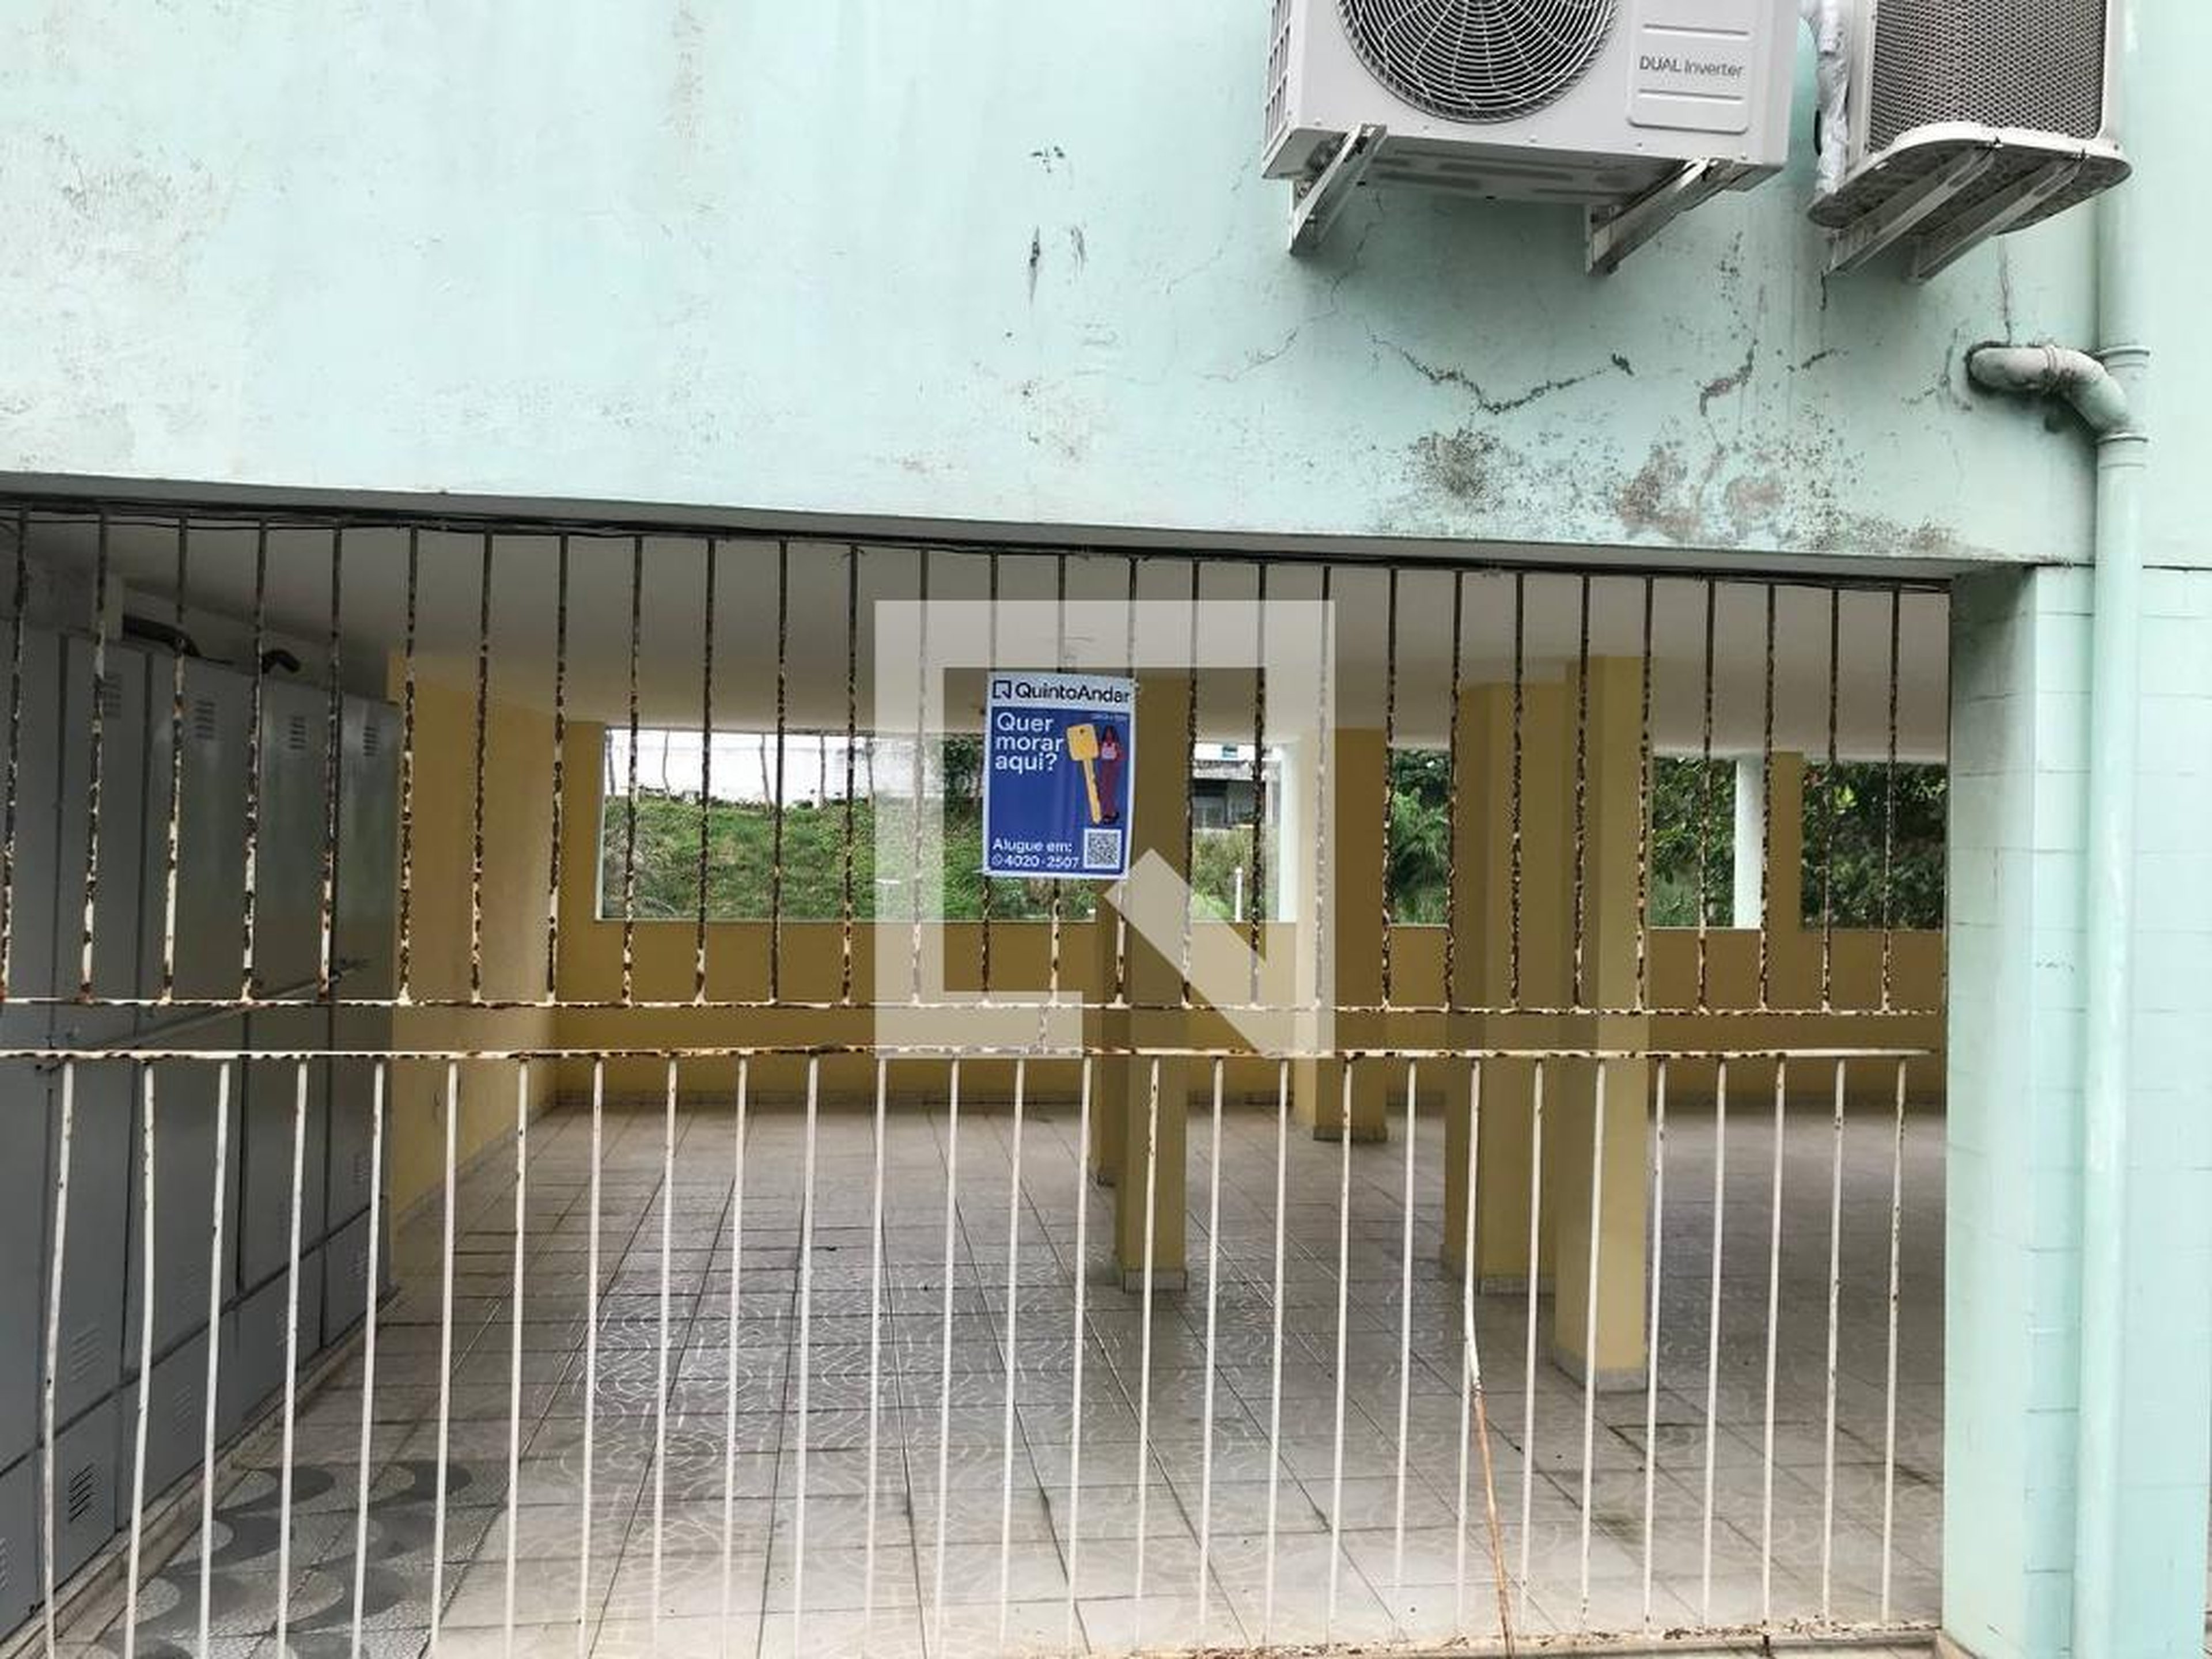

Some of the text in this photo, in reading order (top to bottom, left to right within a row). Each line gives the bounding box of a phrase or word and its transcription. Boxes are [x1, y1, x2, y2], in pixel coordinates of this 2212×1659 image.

[1639, 56, 1743, 78] DUAL Inverter
[1016, 682, 1130, 702] QuintoAndar
[998, 713, 1054, 732] Quer
[996, 736, 1064, 752] morar
[995, 752, 1058, 774] aqui?
[993, 838, 1073, 853] Alugue em:
